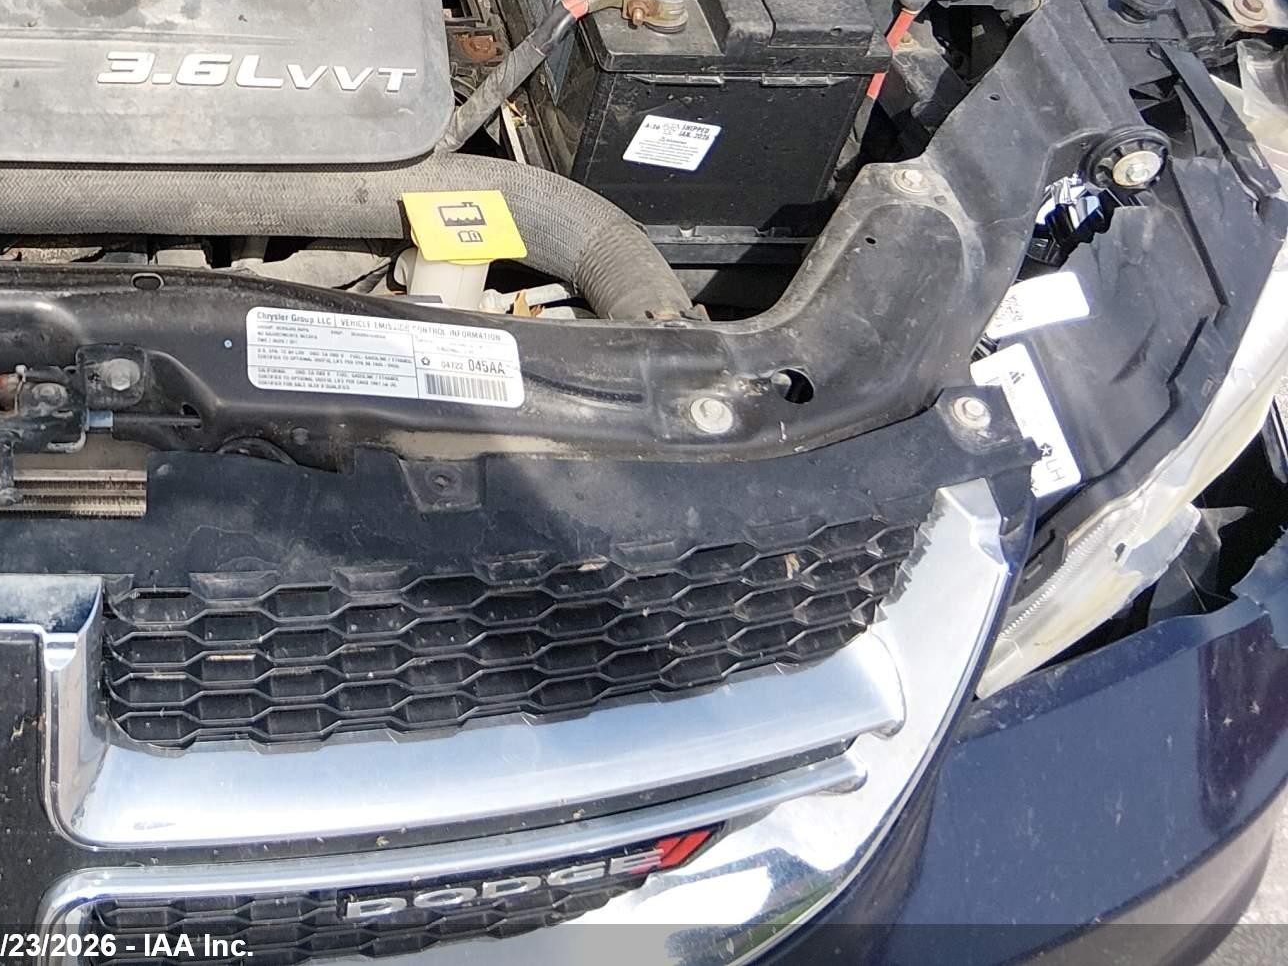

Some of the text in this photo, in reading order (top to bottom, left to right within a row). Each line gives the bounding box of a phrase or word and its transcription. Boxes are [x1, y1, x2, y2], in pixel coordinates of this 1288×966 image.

[286, 64, 417, 93] VVT
[682, 123, 710, 134] SHIPPED
[257, 311, 331, 325] Chrysler Group LLC
[341, 318, 370, 328] VEHICLE
[450, 329, 501, 341] INFORMATION
[468, 358, 505, 375] 045AA
[346, 848, 664, 919] DODGE
